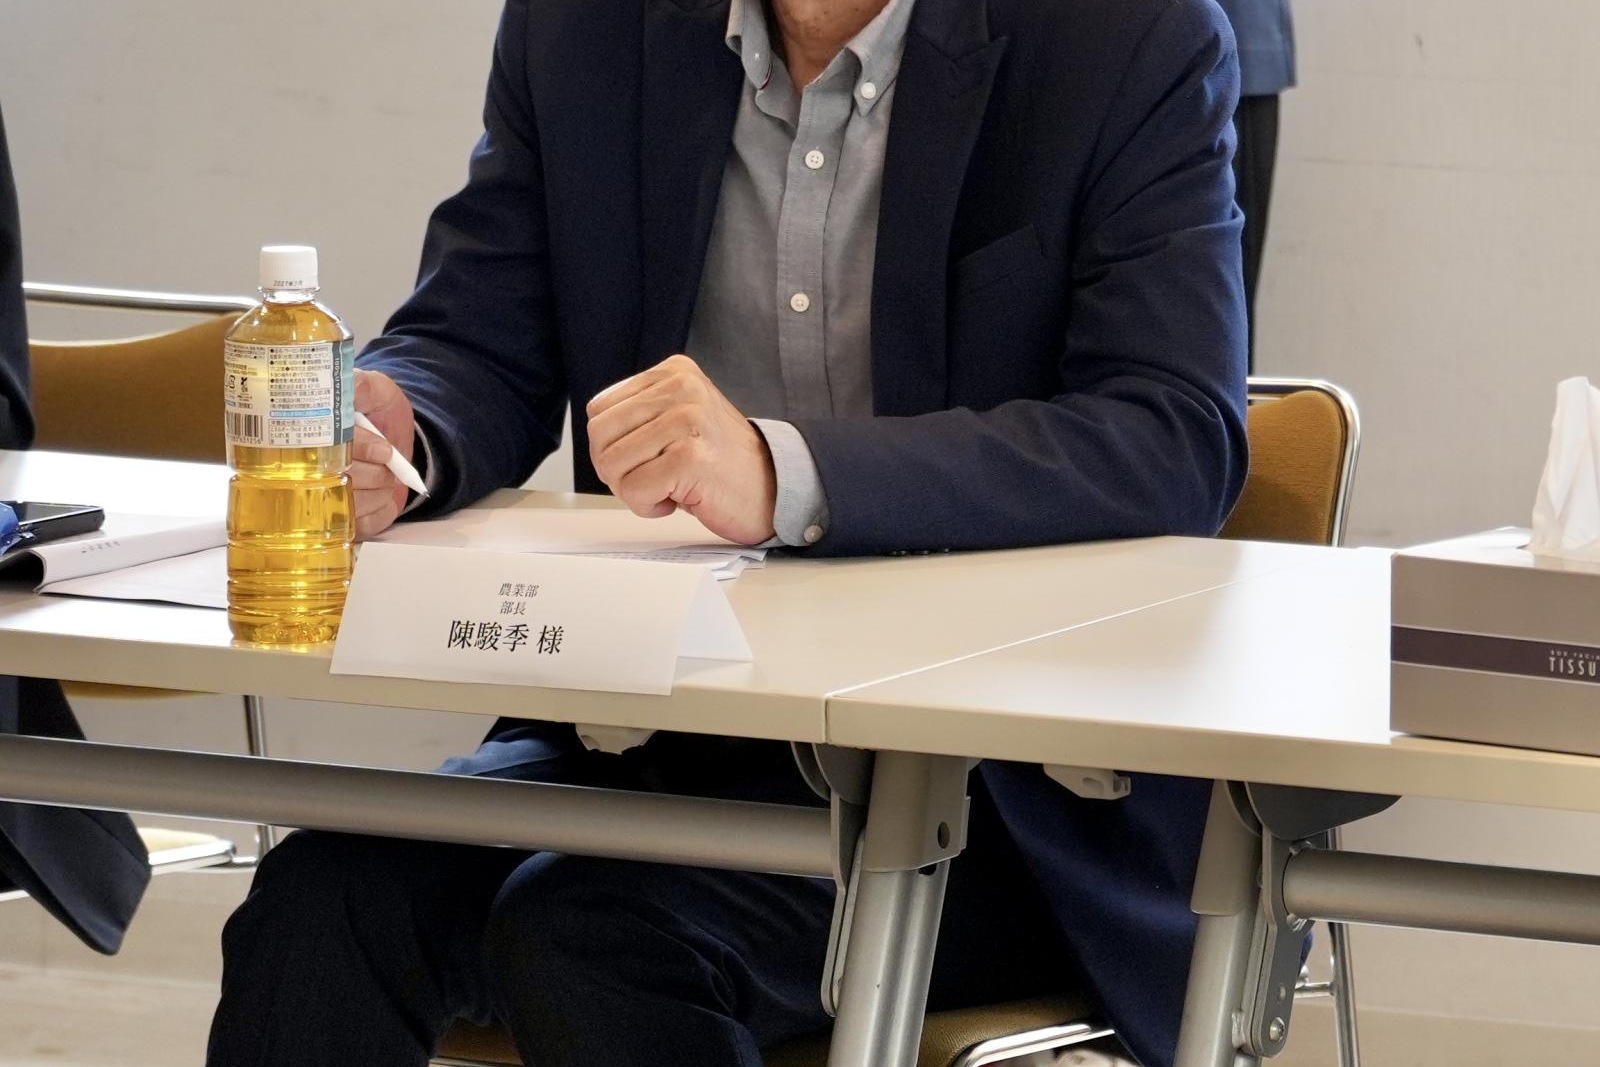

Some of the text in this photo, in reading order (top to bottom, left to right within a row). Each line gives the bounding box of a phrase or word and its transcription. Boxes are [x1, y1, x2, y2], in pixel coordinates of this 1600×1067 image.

[498, 582, 540, 598] 農業部
[499, 600, 527, 615] 部長
[447, 620, 565, 655] 陳駿季 様
